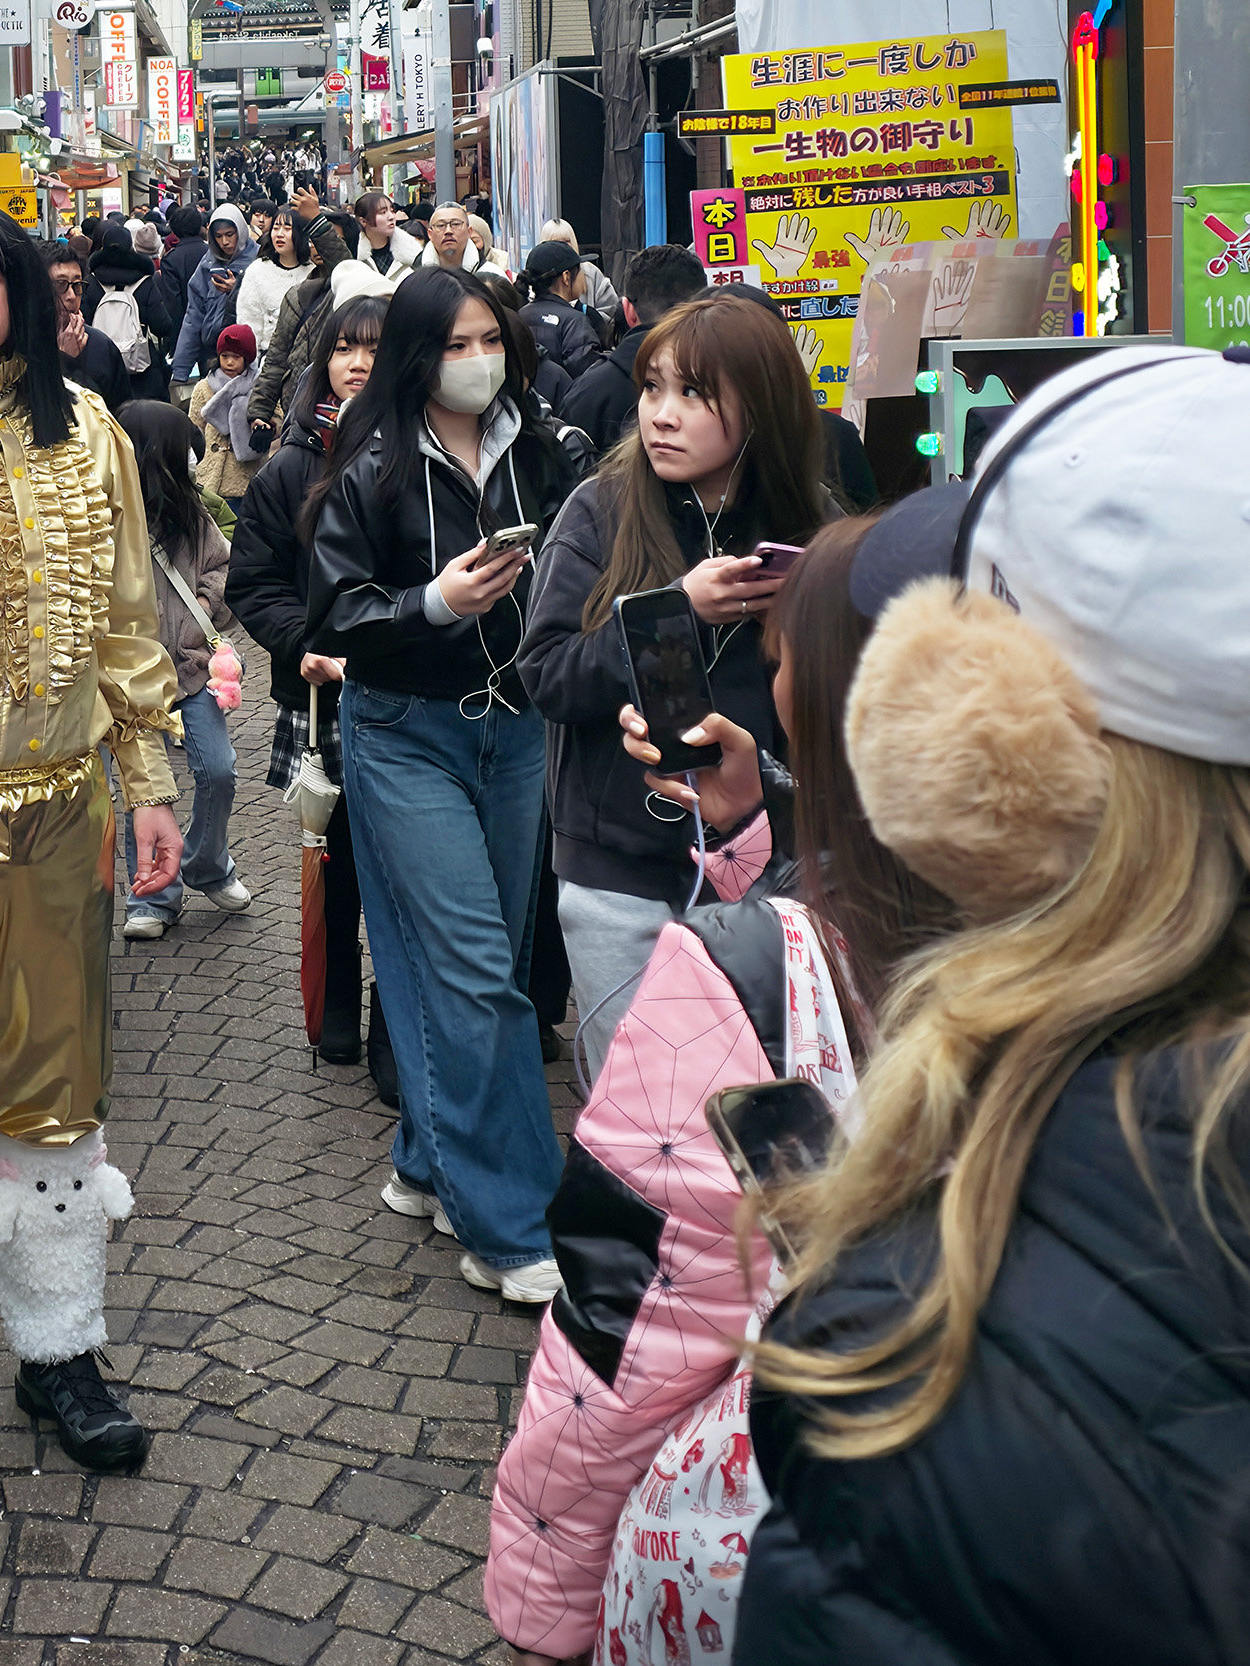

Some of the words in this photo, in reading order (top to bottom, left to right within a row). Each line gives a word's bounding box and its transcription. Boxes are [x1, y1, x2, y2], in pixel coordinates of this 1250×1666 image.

[57, 1, 88, 22] Rio
[150, 60, 174, 70] NOA
[414, 54, 424, 90] TOKYO
[751, 39, 976, 88] 生涯に一度しか
[124, 64, 134, 102] クレープ
[180, 72, 190, 116] プリクラ
[156, 75, 171, 141] COFFEE
[777, 84, 956, 121] お作り出来ない
[753, 117, 975, 162] 一生物の御守り
[812, 250, 851, 269] 最強
